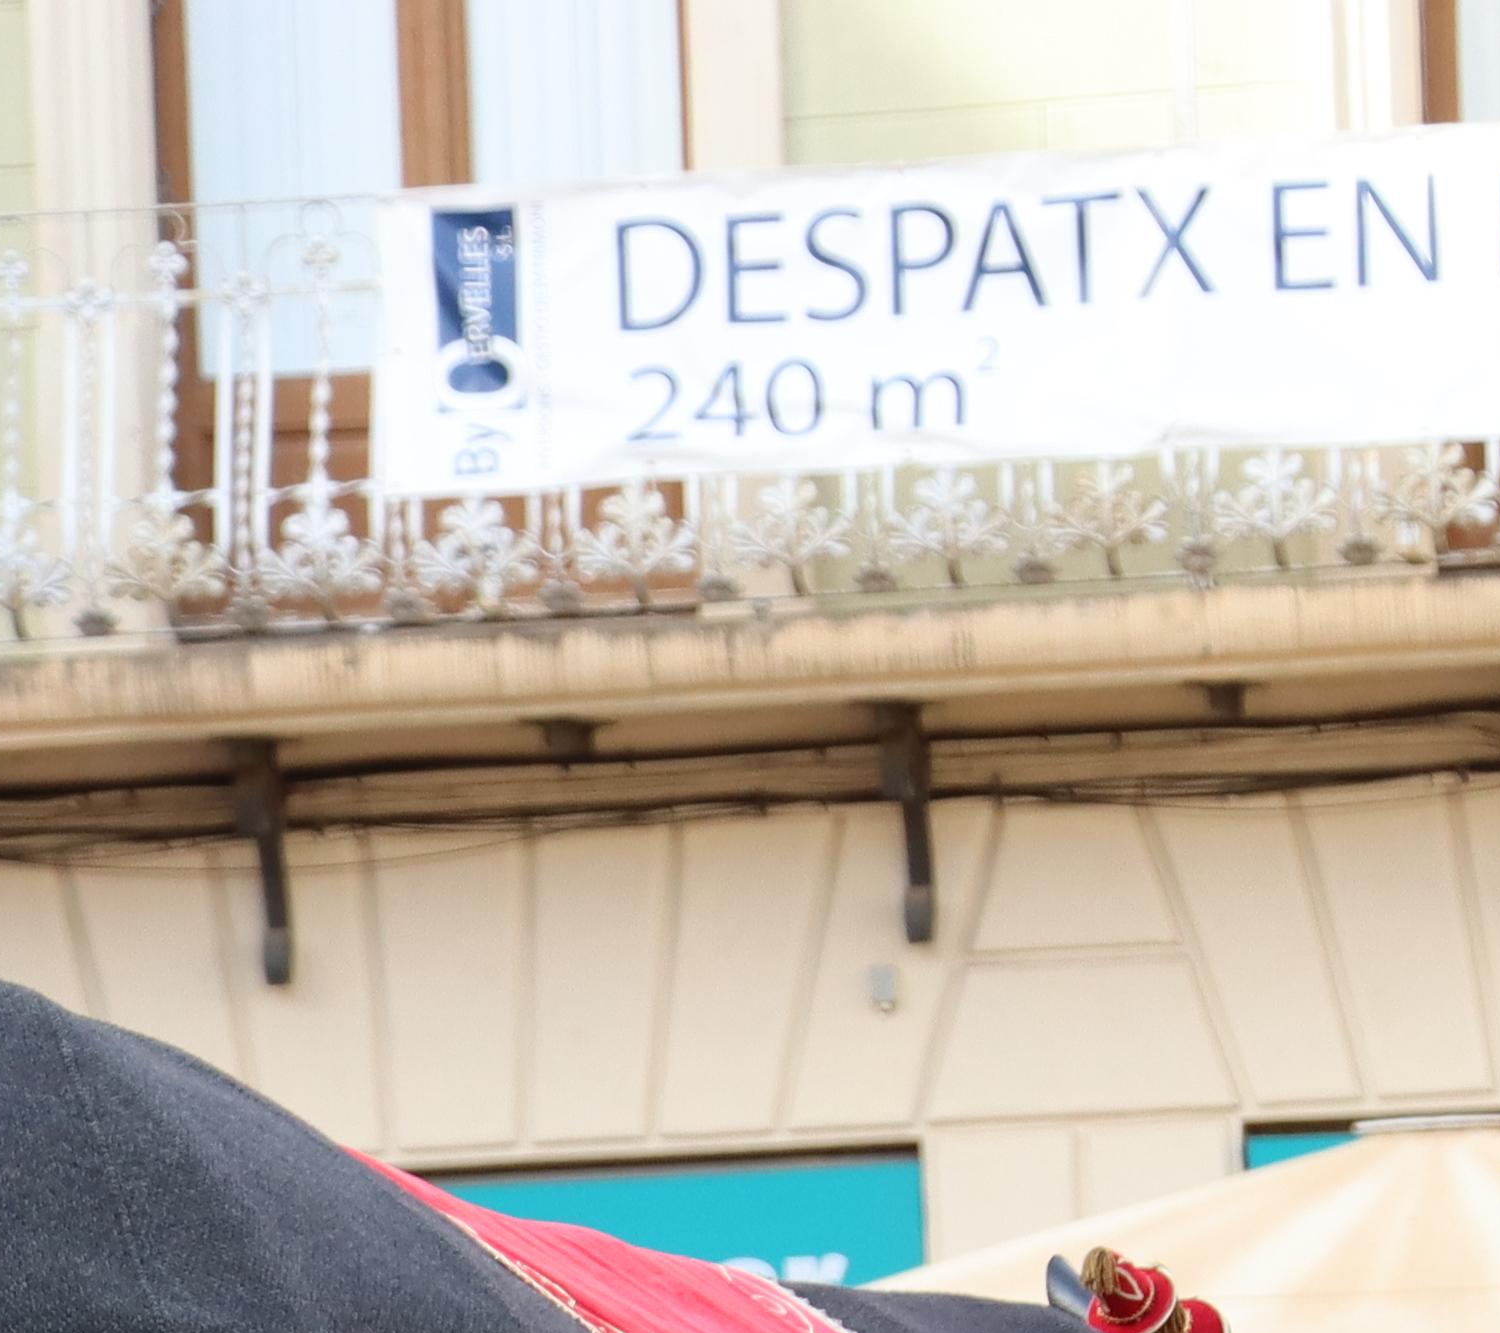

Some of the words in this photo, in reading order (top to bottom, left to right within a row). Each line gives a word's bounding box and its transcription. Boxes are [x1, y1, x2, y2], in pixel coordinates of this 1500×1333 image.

[614, 184, 1218, 332] DESPATX
[1272, 174, 1439, 290] EN
[624, 357, 825, 442] 240
[454, 422, 513, 475] By
